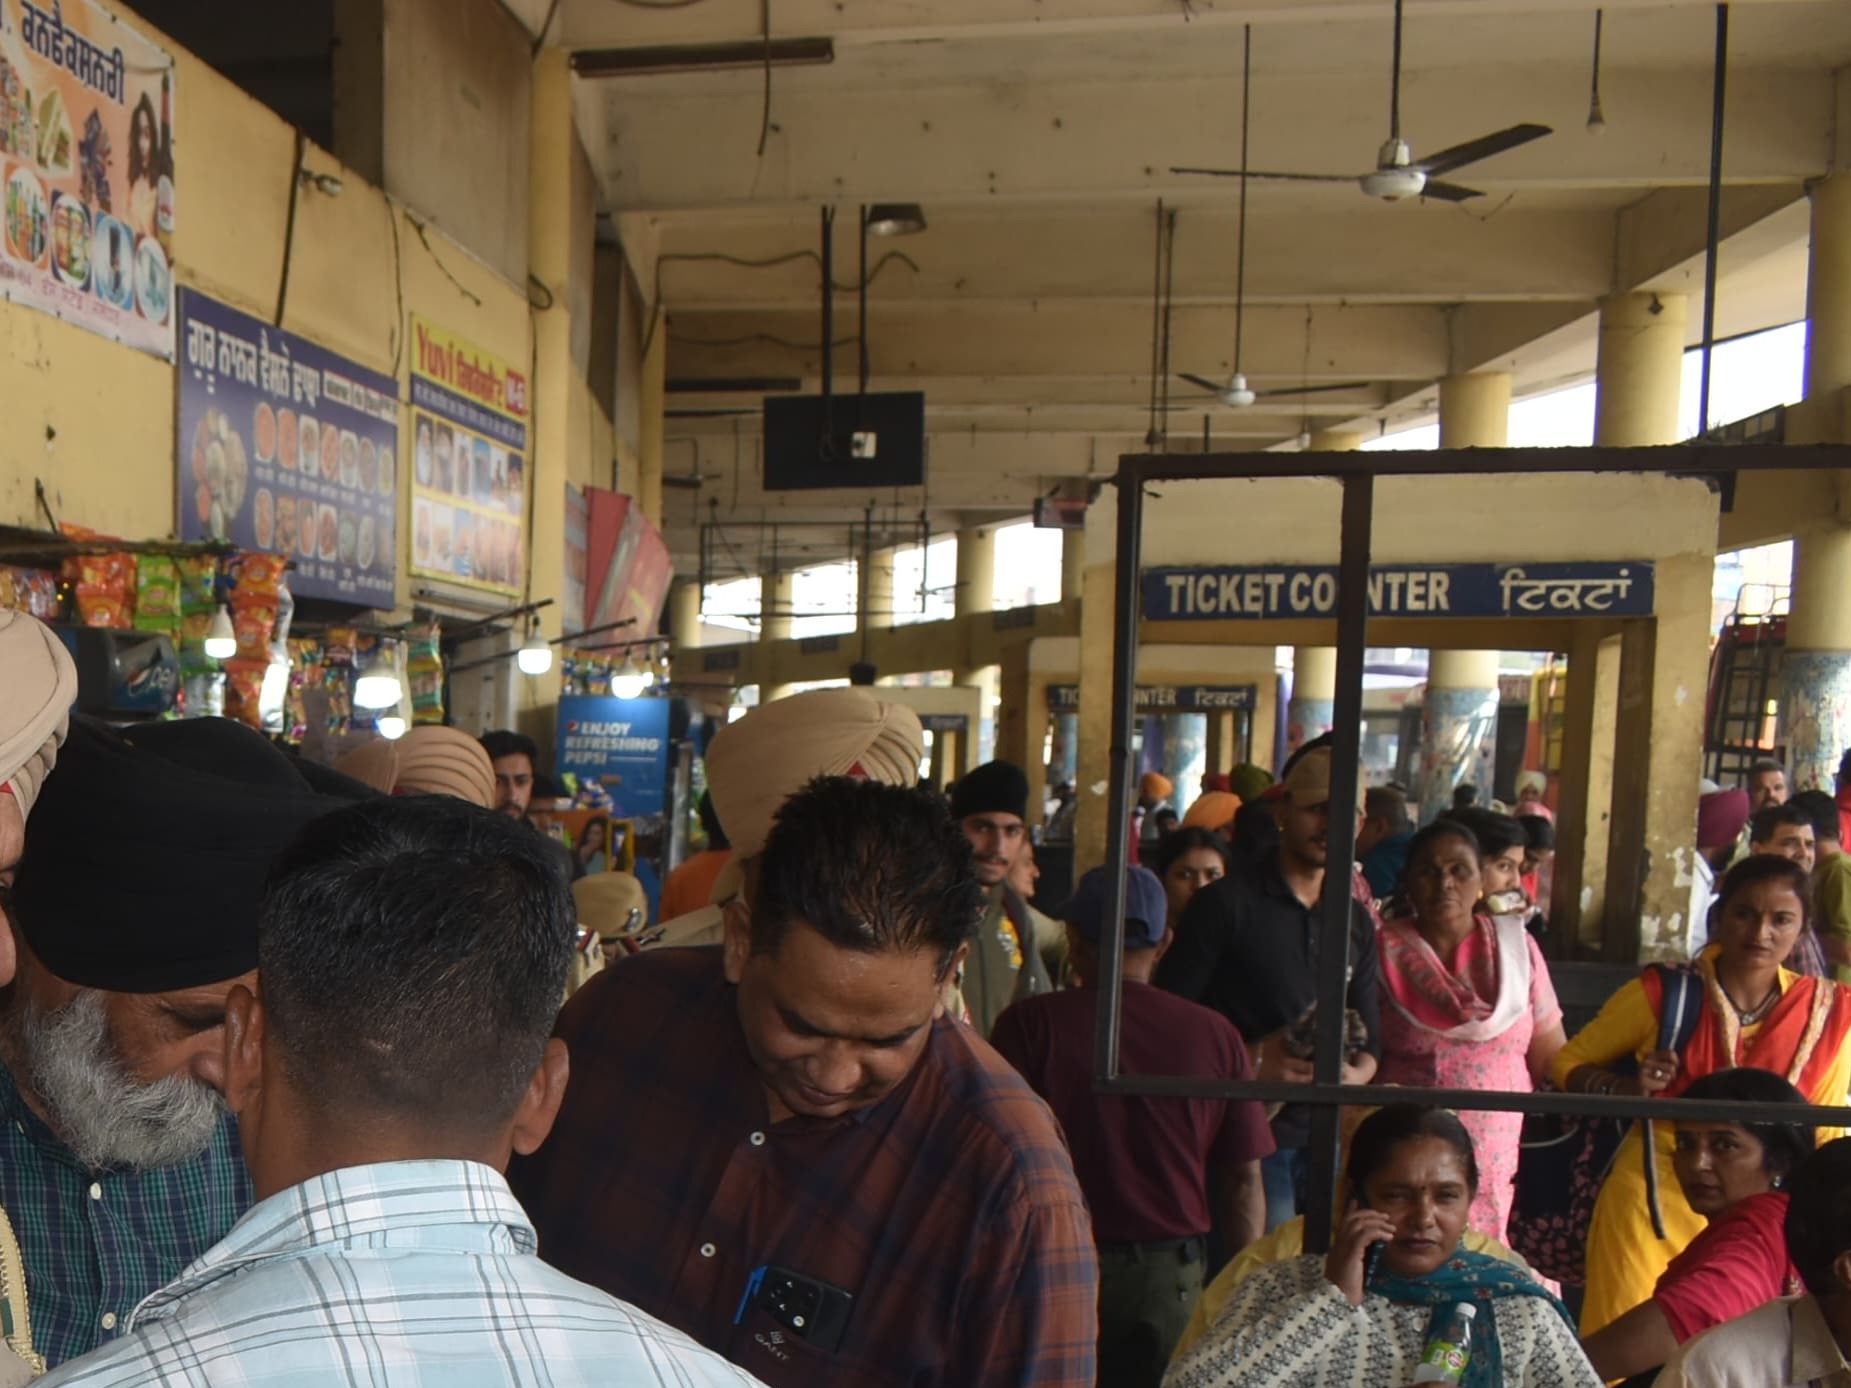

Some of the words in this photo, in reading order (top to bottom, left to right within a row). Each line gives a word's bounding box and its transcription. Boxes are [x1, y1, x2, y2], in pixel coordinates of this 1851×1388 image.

[1165, 573, 1285, 614] TICKET
[1290, 572, 1449, 613] CONTER
[1501, 567, 1632, 612] ਟਿਕਟਾਂ
[581, 722, 632, 736] ENJOY
[565, 736, 661, 751] REFRESHING
[564, 751, 608, 765] PEPSI
